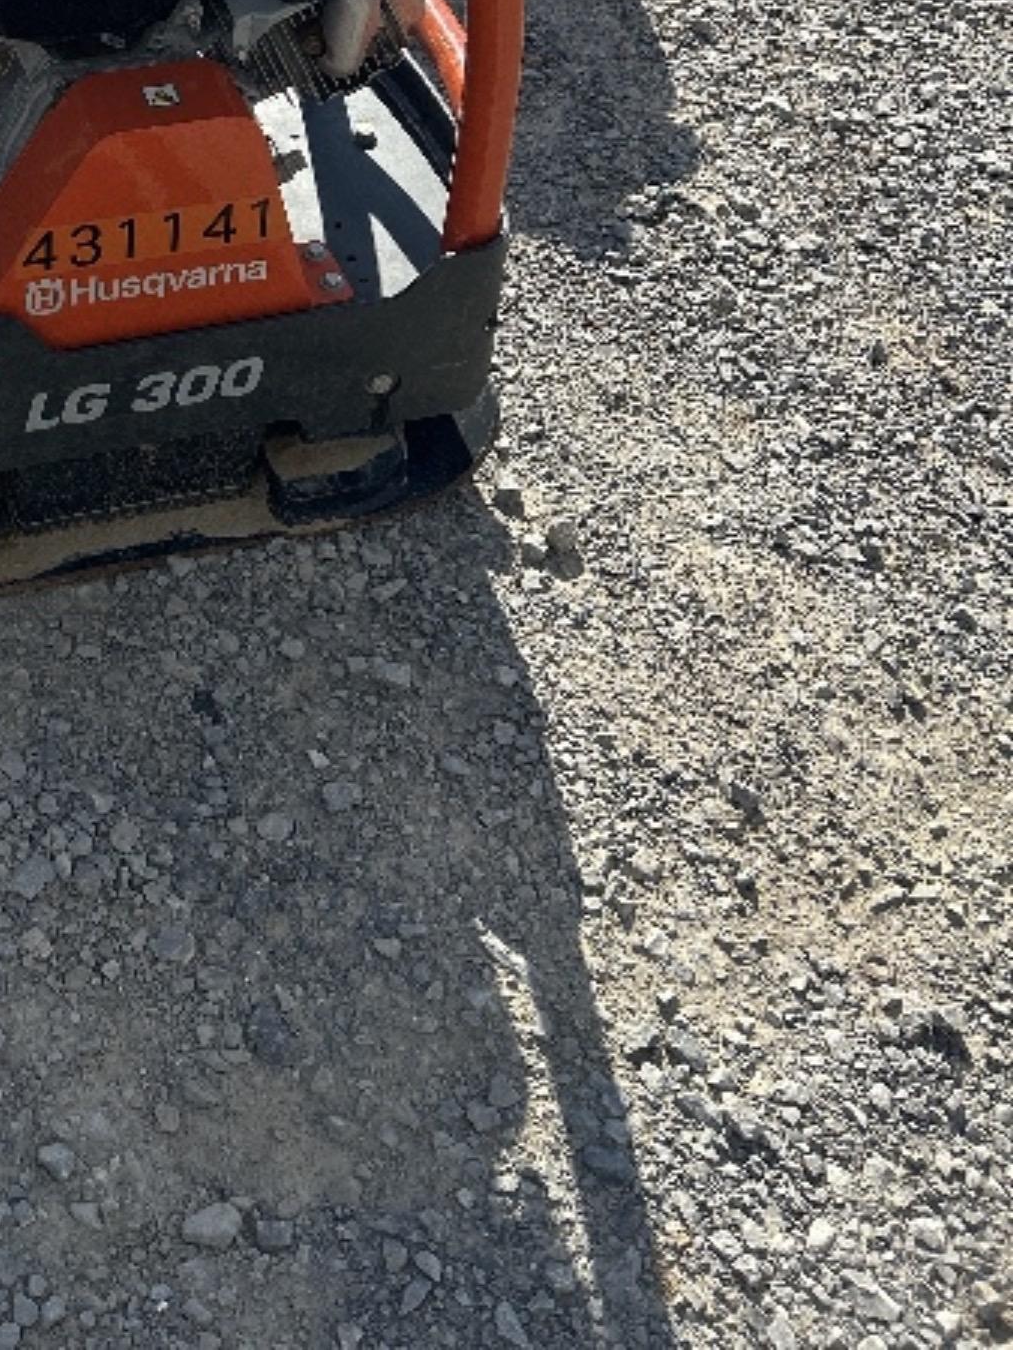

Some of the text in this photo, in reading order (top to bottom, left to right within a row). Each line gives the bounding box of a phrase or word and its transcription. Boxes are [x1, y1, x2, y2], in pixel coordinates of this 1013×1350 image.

[22, 197, 272, 271] 431141
[70, 258, 269, 307] Husqvarna
[24, 356, 265, 433] LG 300
